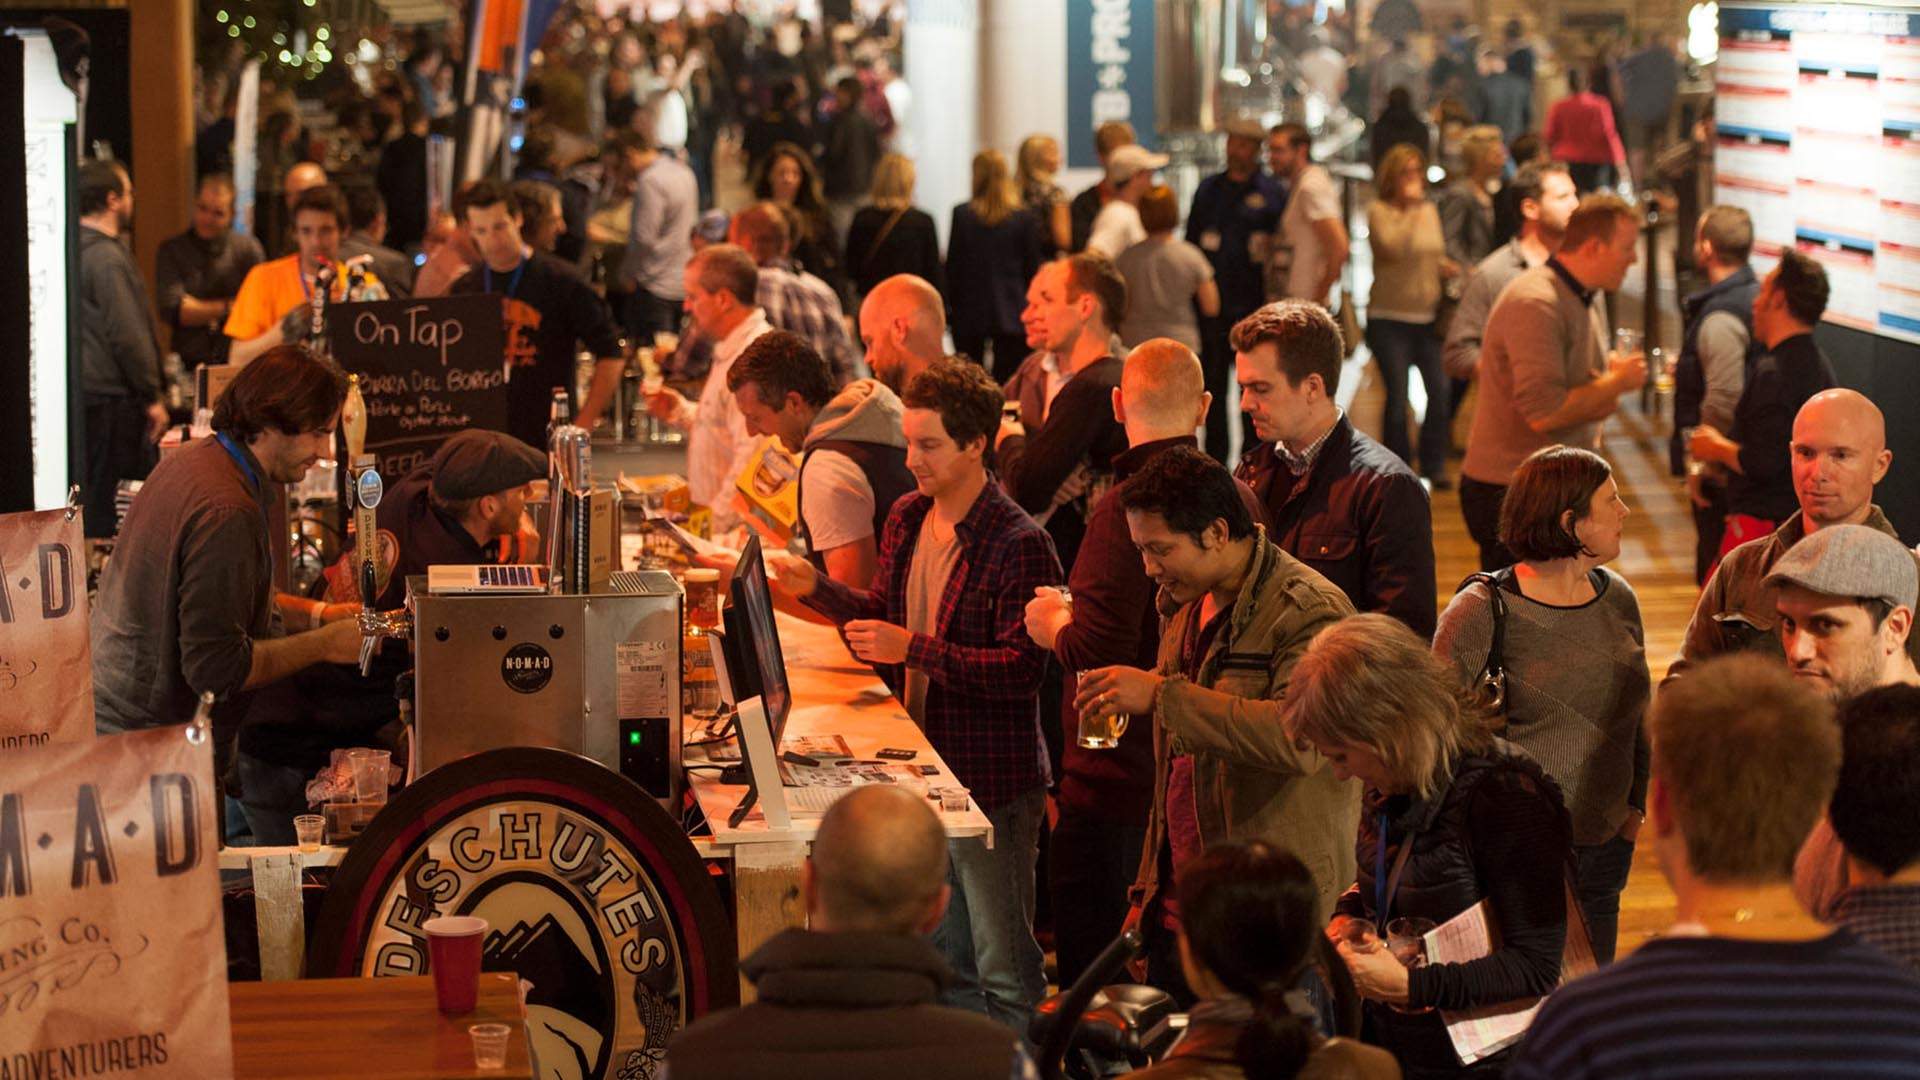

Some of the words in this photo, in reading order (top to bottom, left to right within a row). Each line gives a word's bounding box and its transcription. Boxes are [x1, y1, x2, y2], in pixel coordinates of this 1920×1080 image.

[354, 311, 399, 345] On
[405, 305, 464, 366] Tap
[446, 368, 501, 392] BORGO
[374, 812, 668, 976] DESCHUTES
[60, 917, 111, 945] Co.
[0, 1032, 170, 1080] ADVENTURERS
